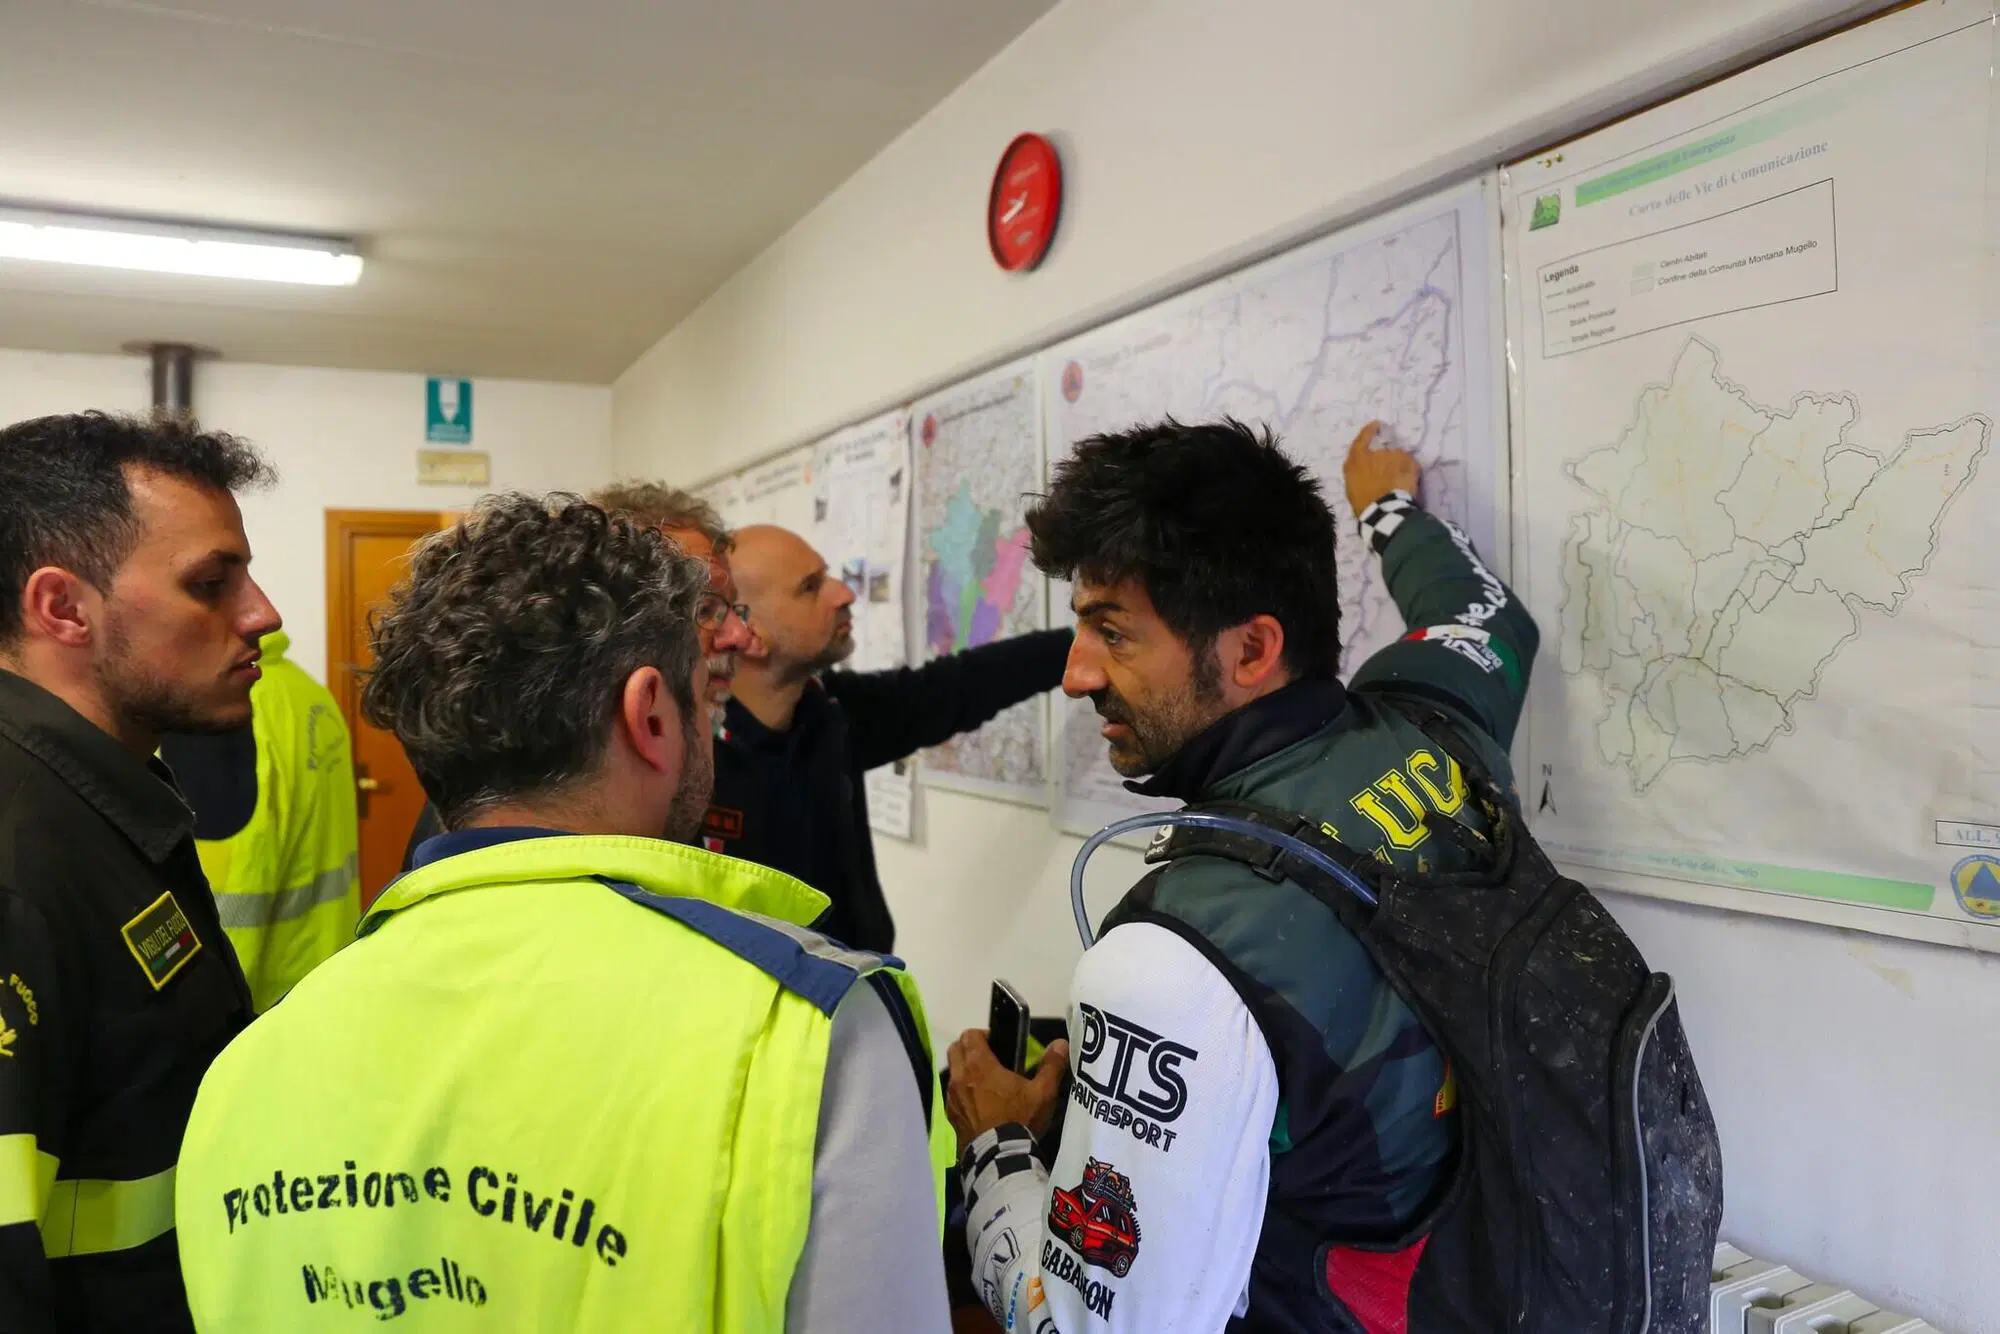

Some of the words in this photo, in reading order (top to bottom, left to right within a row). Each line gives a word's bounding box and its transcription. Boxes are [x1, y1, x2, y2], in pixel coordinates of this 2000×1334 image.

[1664, 189, 1690, 206] delle
[1693, 181, 1713, 197] Vie
[1716, 175, 1728, 189] di
[1731, 141, 1829, 184] Comunicazione
[1544, 265, 1579, 283] Legenda
[1658, 273, 1686, 286] Confine
[1688, 268, 1707, 280] della
[1749, 250, 1783, 265] Montana
[1785, 240, 1818, 256] Mugello
[1542, 763, 1552, 776] N
[1077, 1001, 1199, 1123] PTS
[223, 1160, 451, 1235] Protezione
[467, 1165, 627, 1267] Civile
[302, 1256, 488, 1321] Mugello
